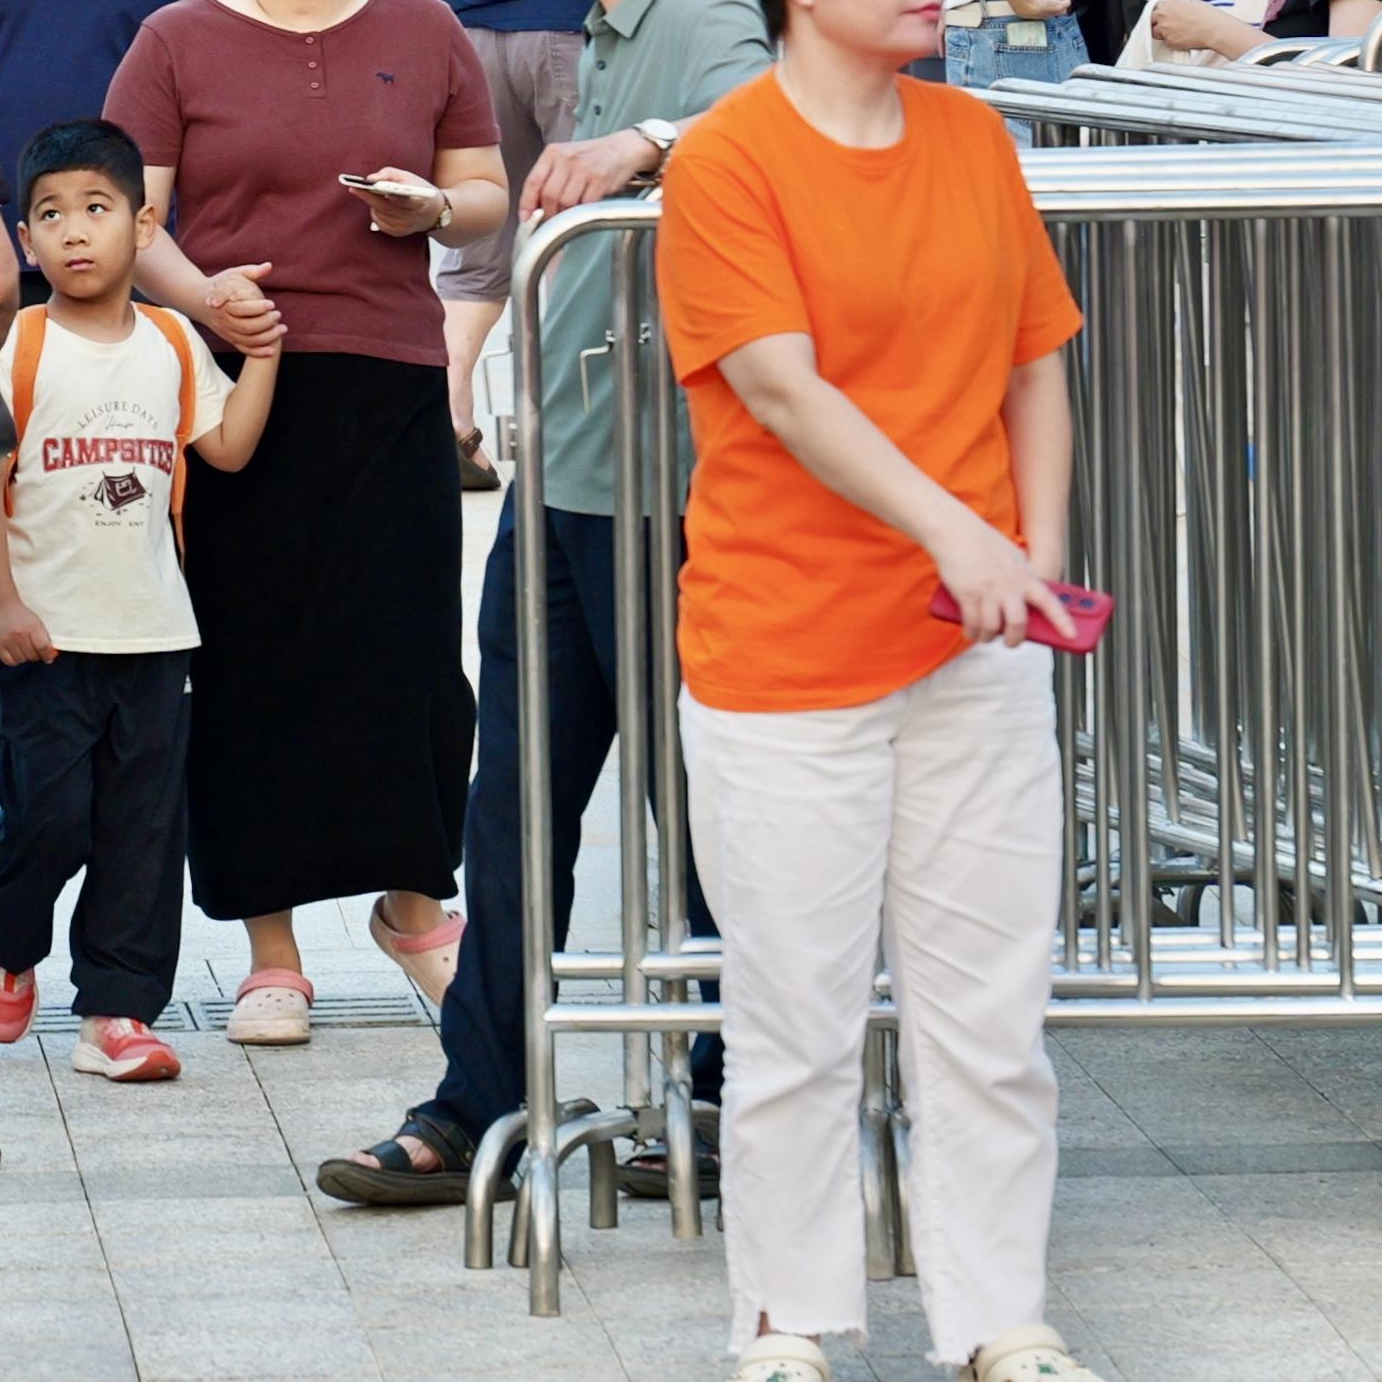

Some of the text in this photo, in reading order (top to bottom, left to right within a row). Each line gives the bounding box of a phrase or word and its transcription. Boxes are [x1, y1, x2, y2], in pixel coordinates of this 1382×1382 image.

[77, 401, 159, 431] LEISURE DAYS
[43, 437, 175, 477] CAMPSITES
